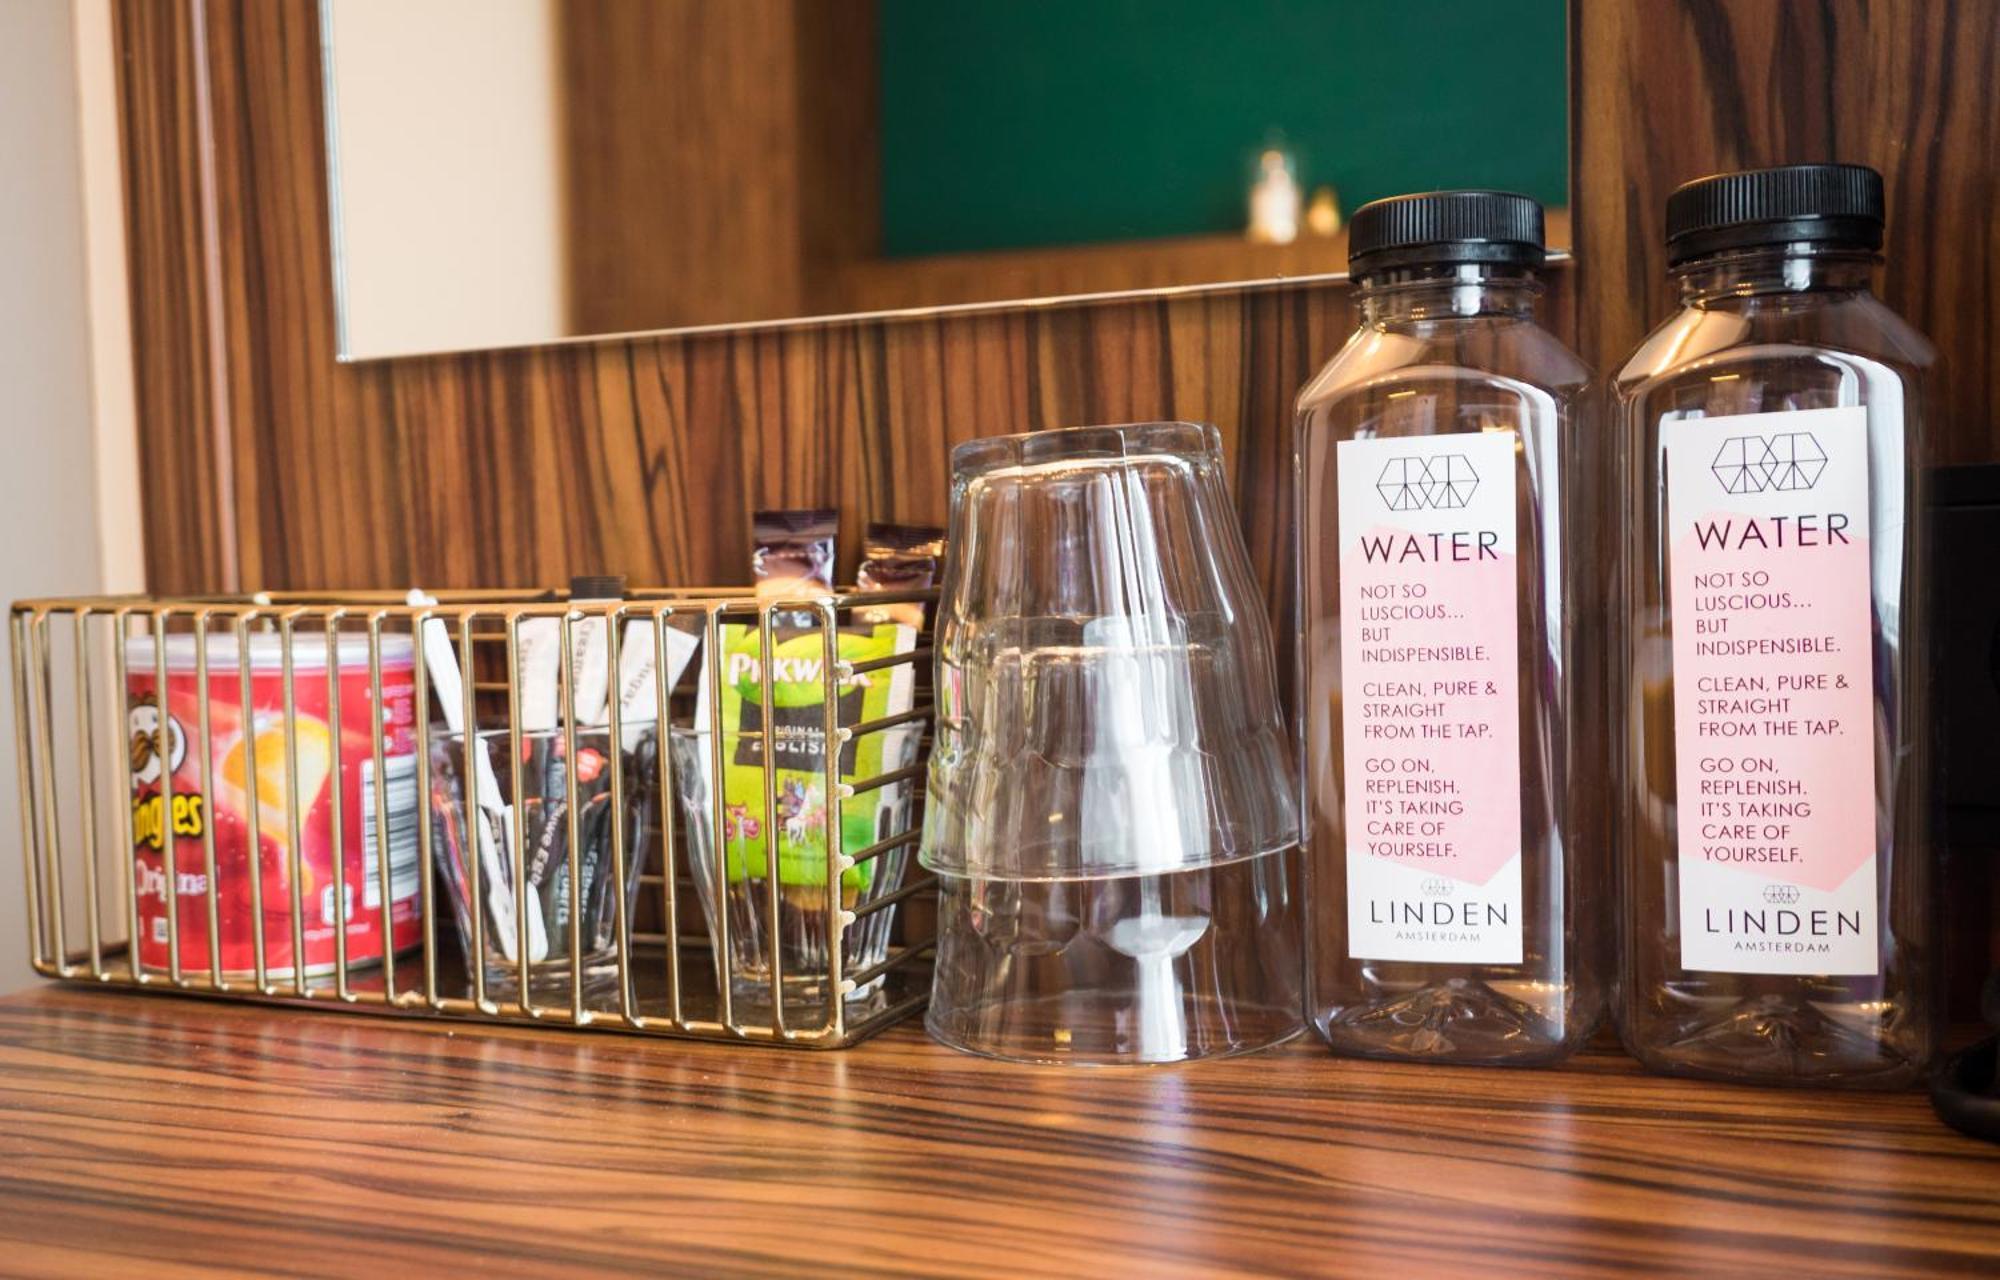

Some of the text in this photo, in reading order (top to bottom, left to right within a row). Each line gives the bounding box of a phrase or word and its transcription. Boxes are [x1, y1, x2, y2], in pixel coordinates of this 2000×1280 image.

[1693, 513, 1850, 552] WATER
[1361, 531, 1499, 564] WATER
[1694, 571, 1770, 589] NOT SO
[1361, 583, 1427, 600] NOT SO
[1696, 618, 1729, 634] BUT
[1362, 627, 1390, 643] BUT
[1362, 646, 1490, 662] INDISPENSIBLE.
[1696, 637, 1841, 656] INDISPENSIBLE.
[1363, 681, 1498, 698] CLEAN, PURE &
[1697, 674, 1850, 693] CLEAN, PURE &
[1363, 703, 1445, 718] STRAIGHT
[1697, 698, 1791, 714] STRAIGHT
[1364, 724, 1493, 740] FROM THE TAP.
[1699, 720, 1844, 738] FROM THE TAP.
[1365, 758, 1435, 775] GO ON,
[1699, 758, 1780, 775] GO ON,
[1365, 780, 1460, 795] REPLENISH.
[1700, 780, 1808, 796] REPLENISH.
[1366, 800, 1464, 816] IT'S TAKING
[1701, 802, 1812, 818] IT'S TAKING
[1367, 821, 1446, 836] CARE OF
[1701, 824, 1791, 840] CARE OF
[1367, 842, 1457, 858] YOURSELF.
[1702, 846, 1804, 863] YOURSELF.
[1370, 900, 1508, 927] LINDEN
[1705, 908, 1861, 937] LINDEN
[1395, 930, 1481, 942] AMSTERDAM
[1733, 940, 1831, 953] AMSTERDAM
